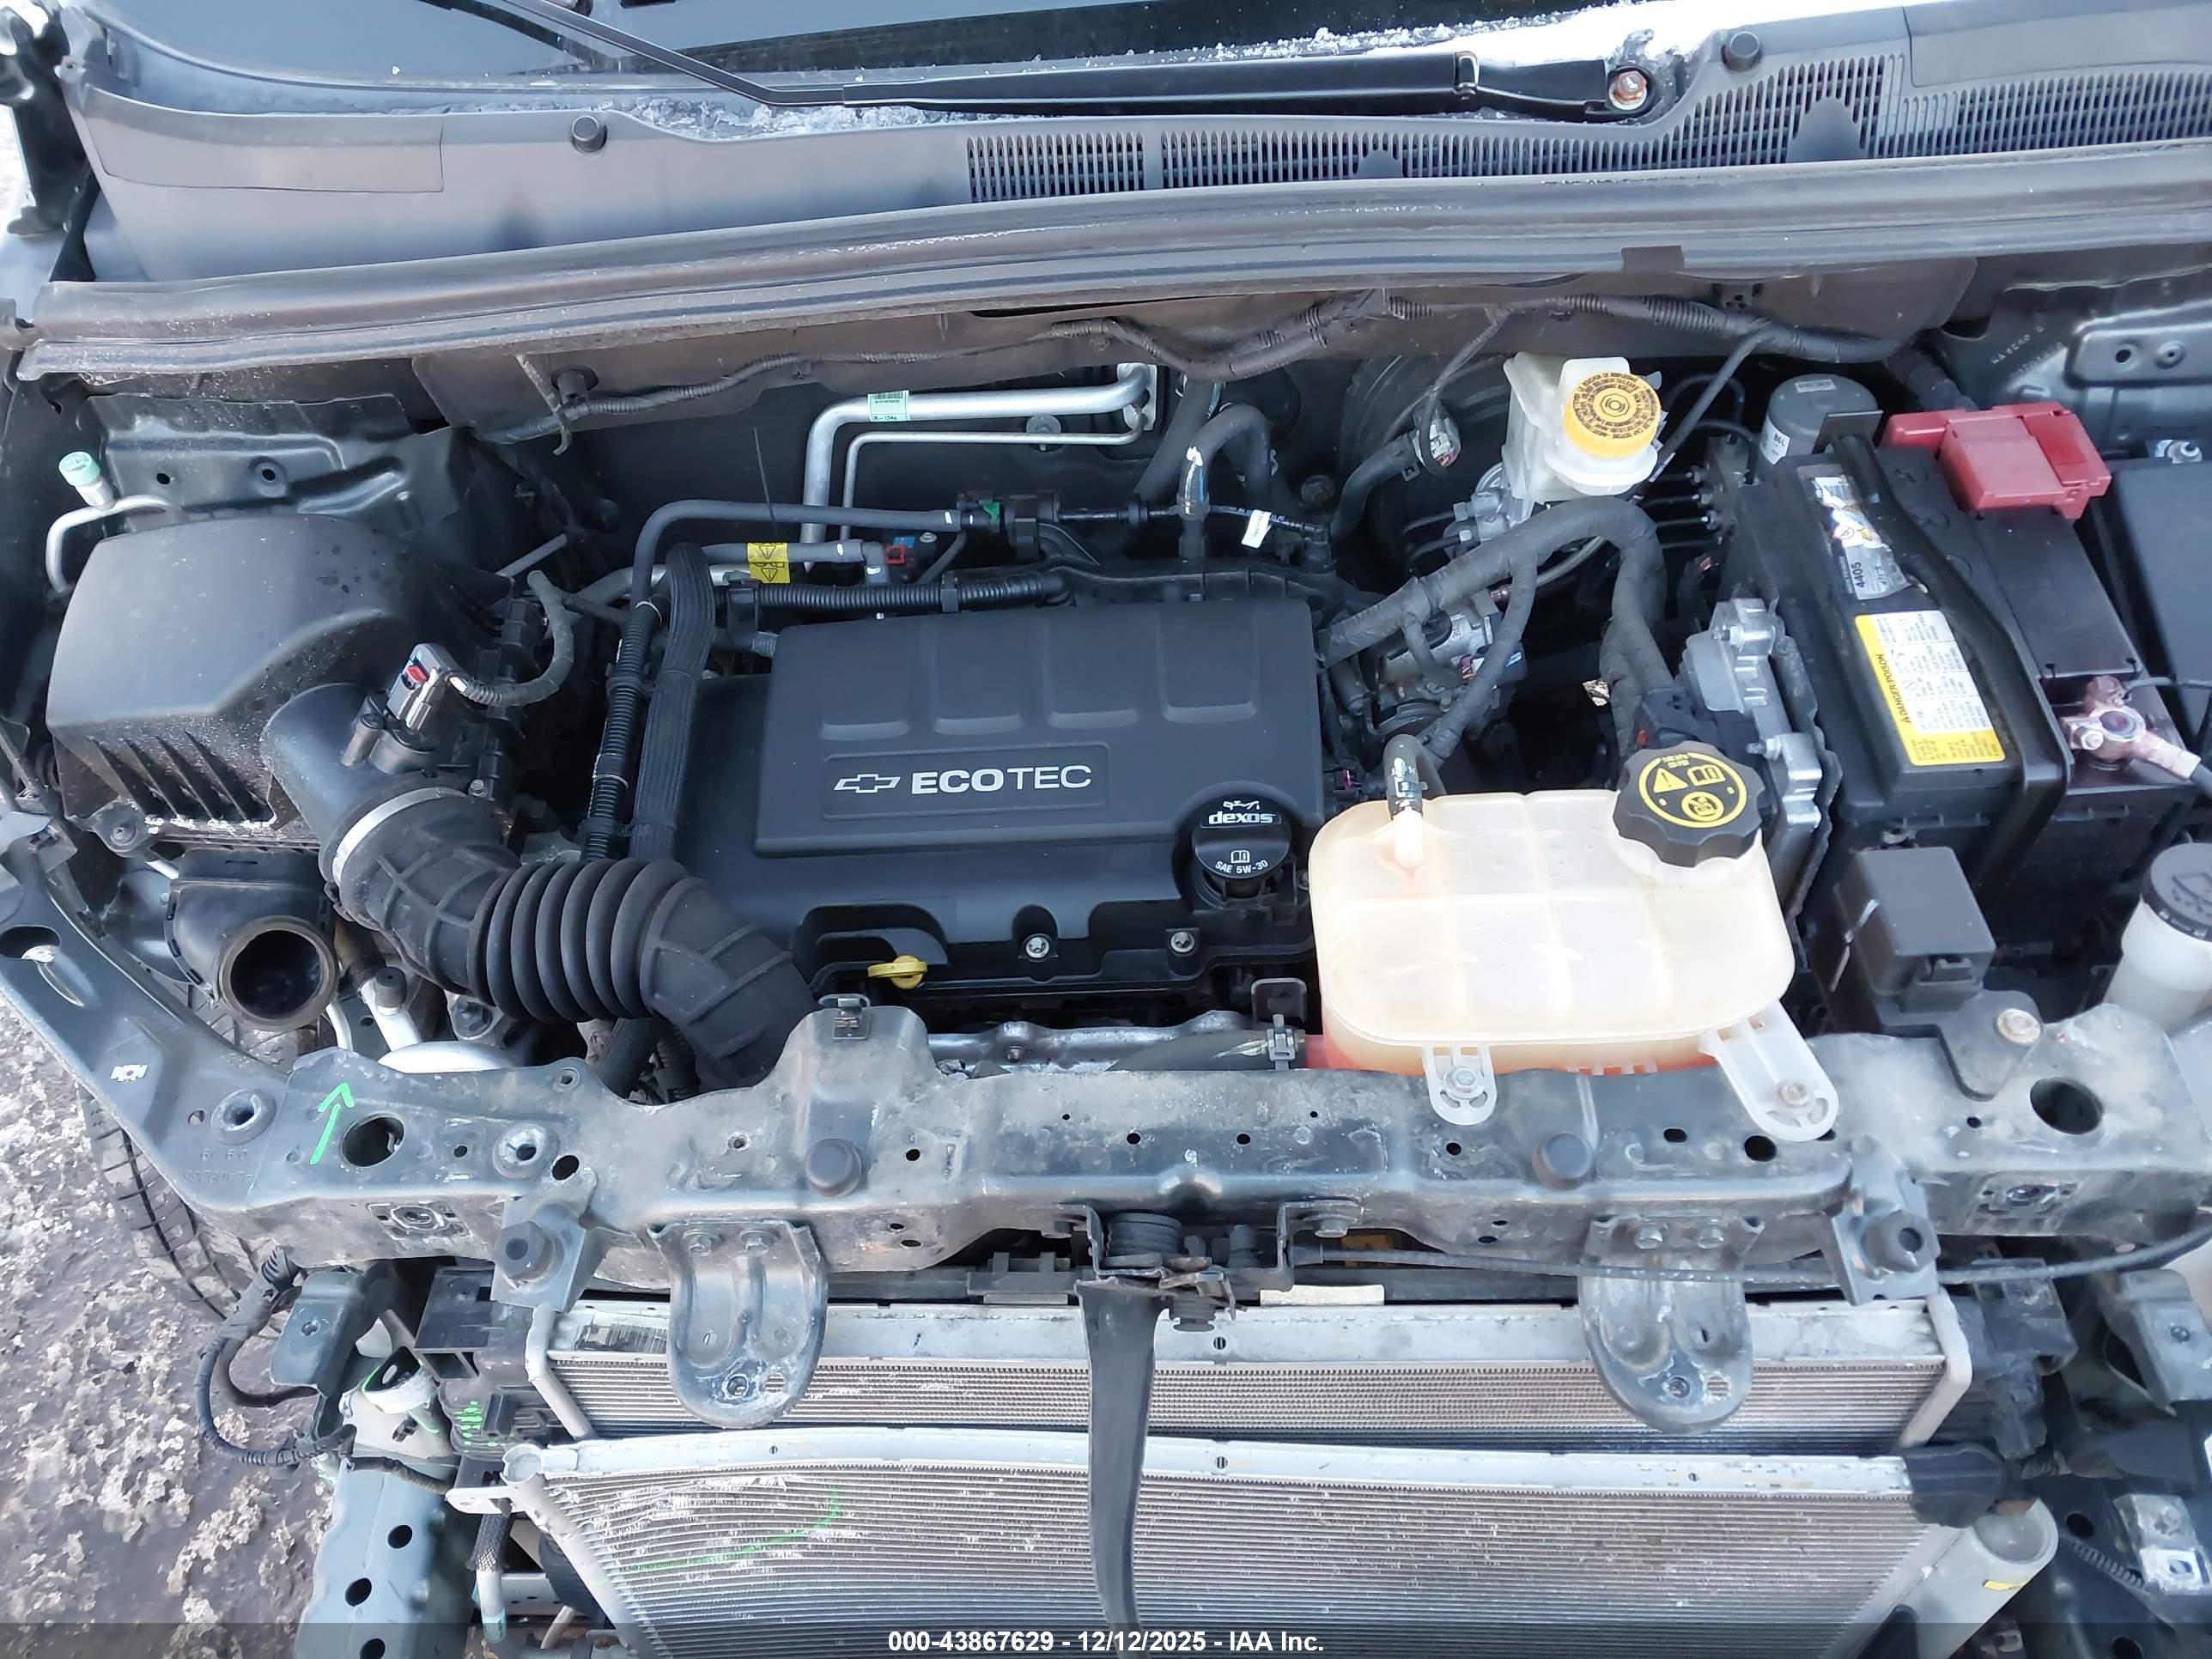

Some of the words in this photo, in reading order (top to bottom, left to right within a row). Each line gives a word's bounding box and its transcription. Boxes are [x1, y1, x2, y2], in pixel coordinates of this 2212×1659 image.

[1850, 562, 1865, 588] 4405
[911, 765, 1091, 794] ECOTEC
[1215, 860, 1233, 874] SAE
[1236, 860, 1269, 874] 5W-30
